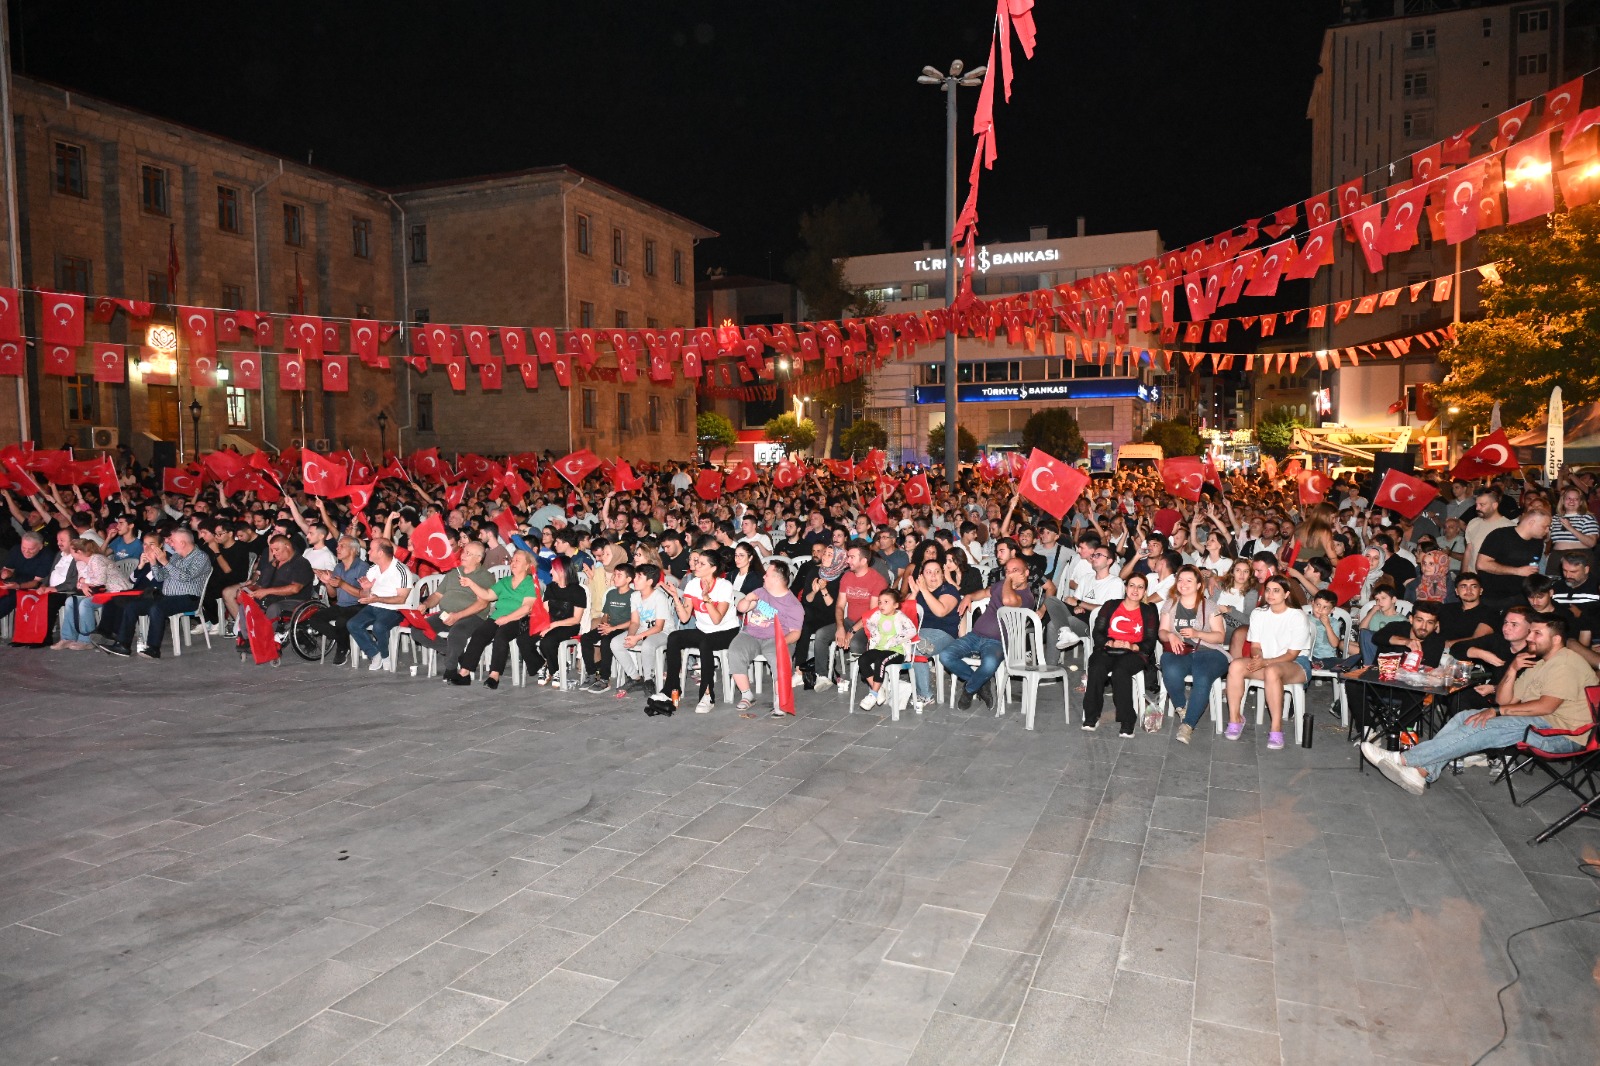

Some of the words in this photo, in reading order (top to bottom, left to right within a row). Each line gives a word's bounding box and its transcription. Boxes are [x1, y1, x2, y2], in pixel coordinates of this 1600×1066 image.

[914, 256, 975, 271] TÜRY
[992, 249, 1059, 265] BANKASI
[982, 386, 1018, 396] TÜRKİYE
[1028, 385, 1068, 395] BANKASI
